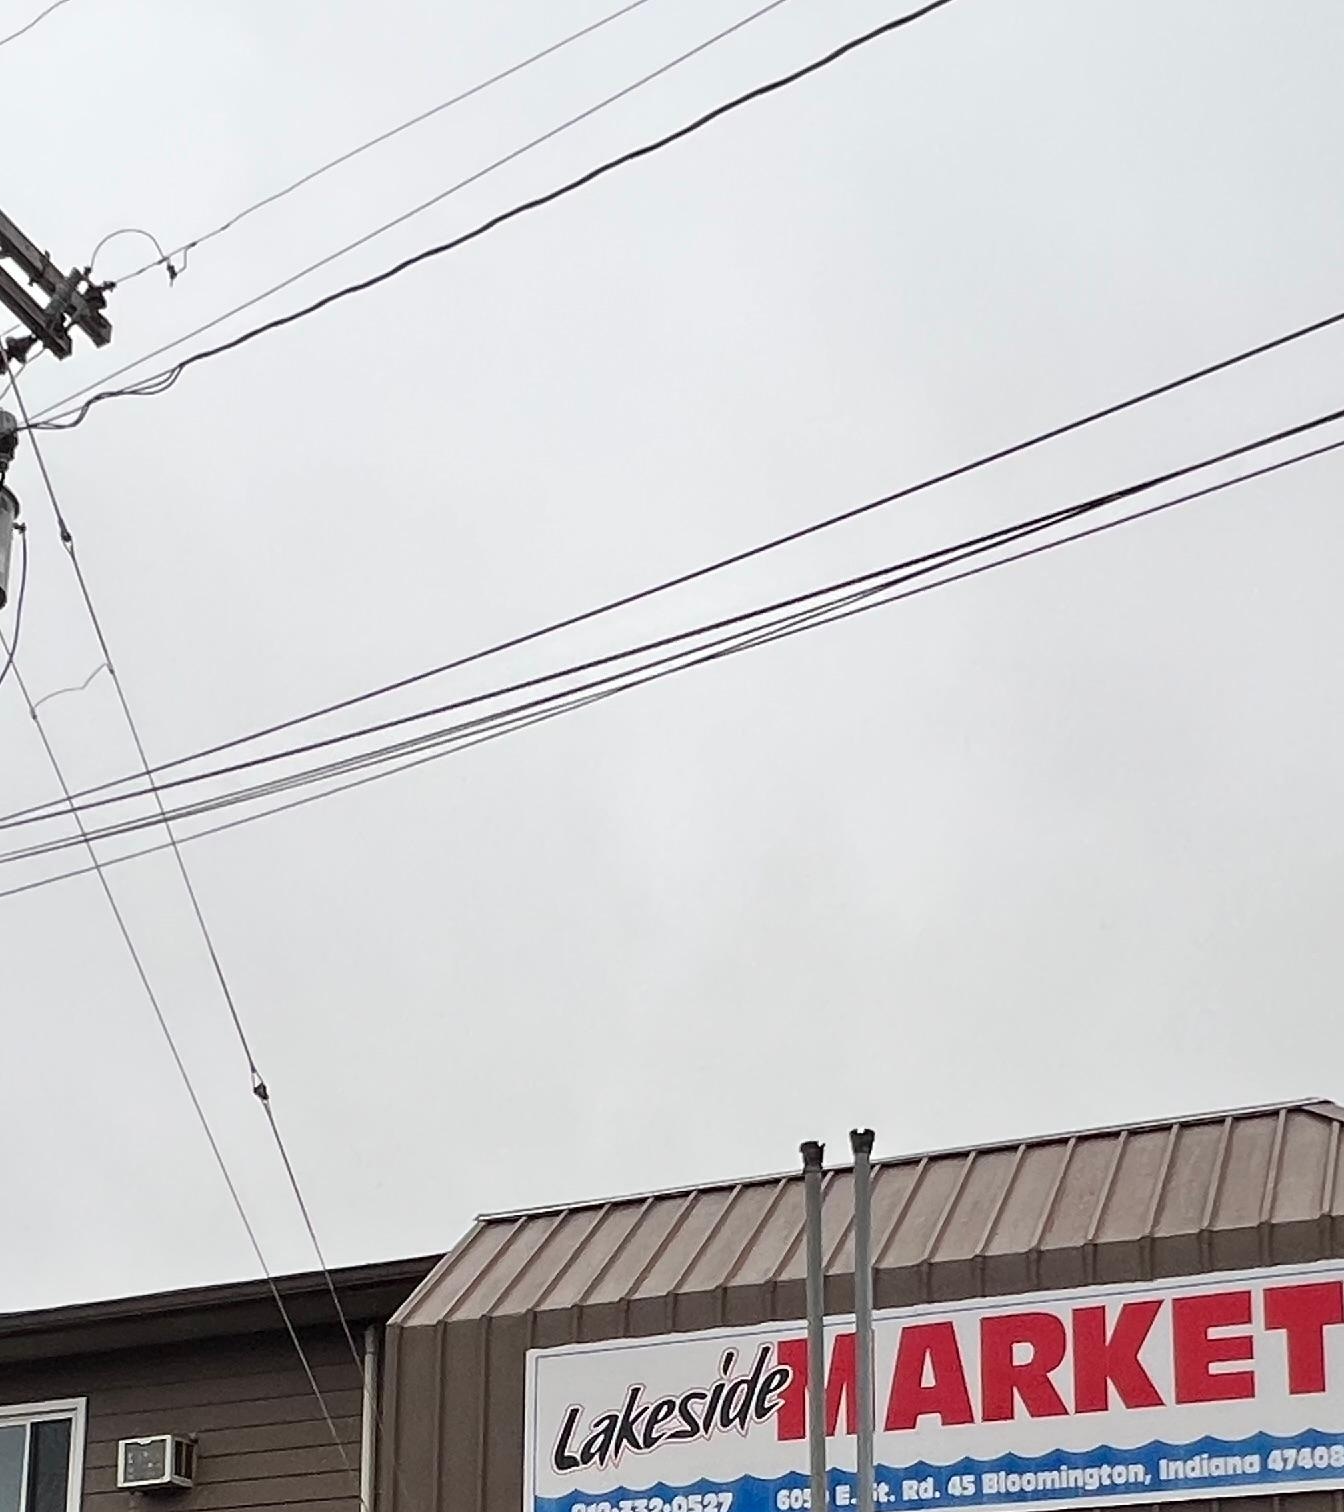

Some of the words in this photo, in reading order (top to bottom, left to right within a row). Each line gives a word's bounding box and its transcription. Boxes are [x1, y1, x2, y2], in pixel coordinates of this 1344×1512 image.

[555, 1344, 793, 1472] Lakeside
[776, 1280, 1344, 1442] MARKET
[776, 1487, 830, 1511] 605
[834, 1483, 858, 1506] E.
[901, 1479, 941, 1502] Rd.
[948, 1474, 976, 1497] 45
[982, 1461, 1152, 1496] Bloomington,
[1158, 1451, 1260, 1481] Indiana
